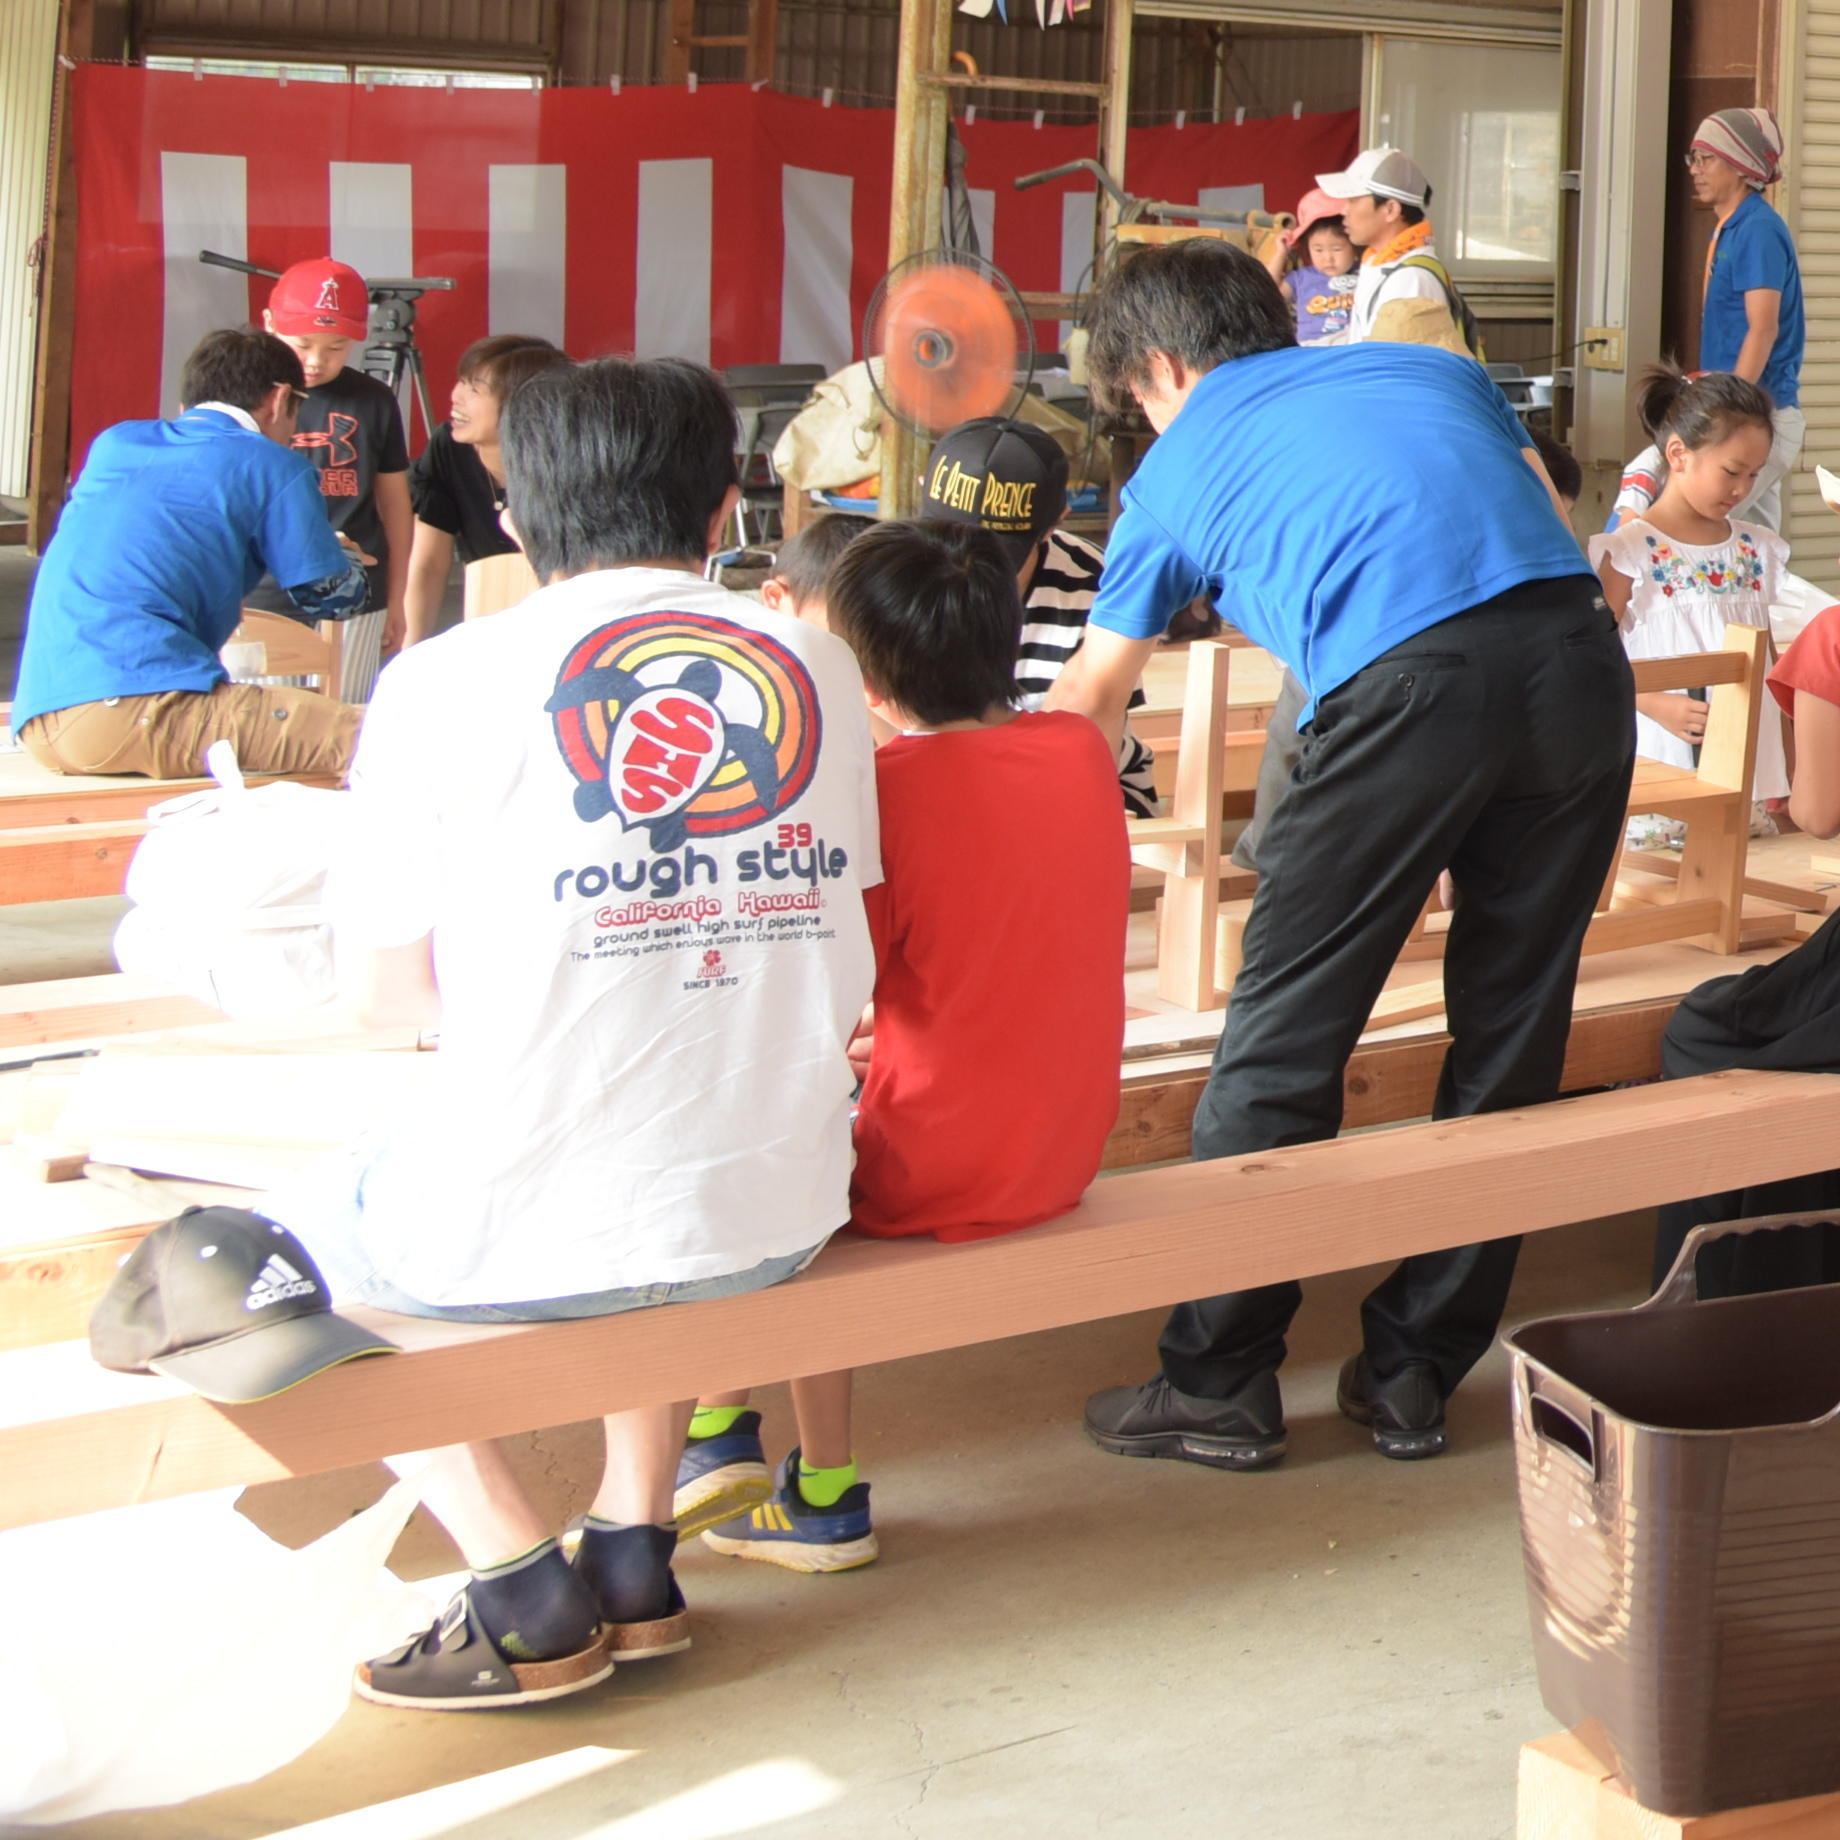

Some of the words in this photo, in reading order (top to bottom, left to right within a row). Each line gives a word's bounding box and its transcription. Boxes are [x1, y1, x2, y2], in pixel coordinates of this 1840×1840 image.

[943, 460, 981, 514] PETIT
[777, 823, 813, 848] 39
[554, 845, 718, 902] rough
[736, 838, 848, 888] style
[594, 895, 722, 928] California
[738, 888, 820, 917] Hawaii
[570, 951, 591, 962] The
[593, 946, 640, 959] meeting
[642, 940, 673, 953] which
[675, 937, 714, 949] enjoys
[716, 936, 742, 946] wave
[744, 933, 754, 943] in
[757, 932, 774, 943] the
[777, 930, 804, 942] world
[593, 927, 650, 948] ground
[654, 922, 693, 939] swell
[697, 917, 730, 935] high
[733, 916, 764, 932] surf
[767, 914, 822, 930] pipeline
[683, 979, 711, 990] SINCE
[246, 1280, 317, 1310] adidas
